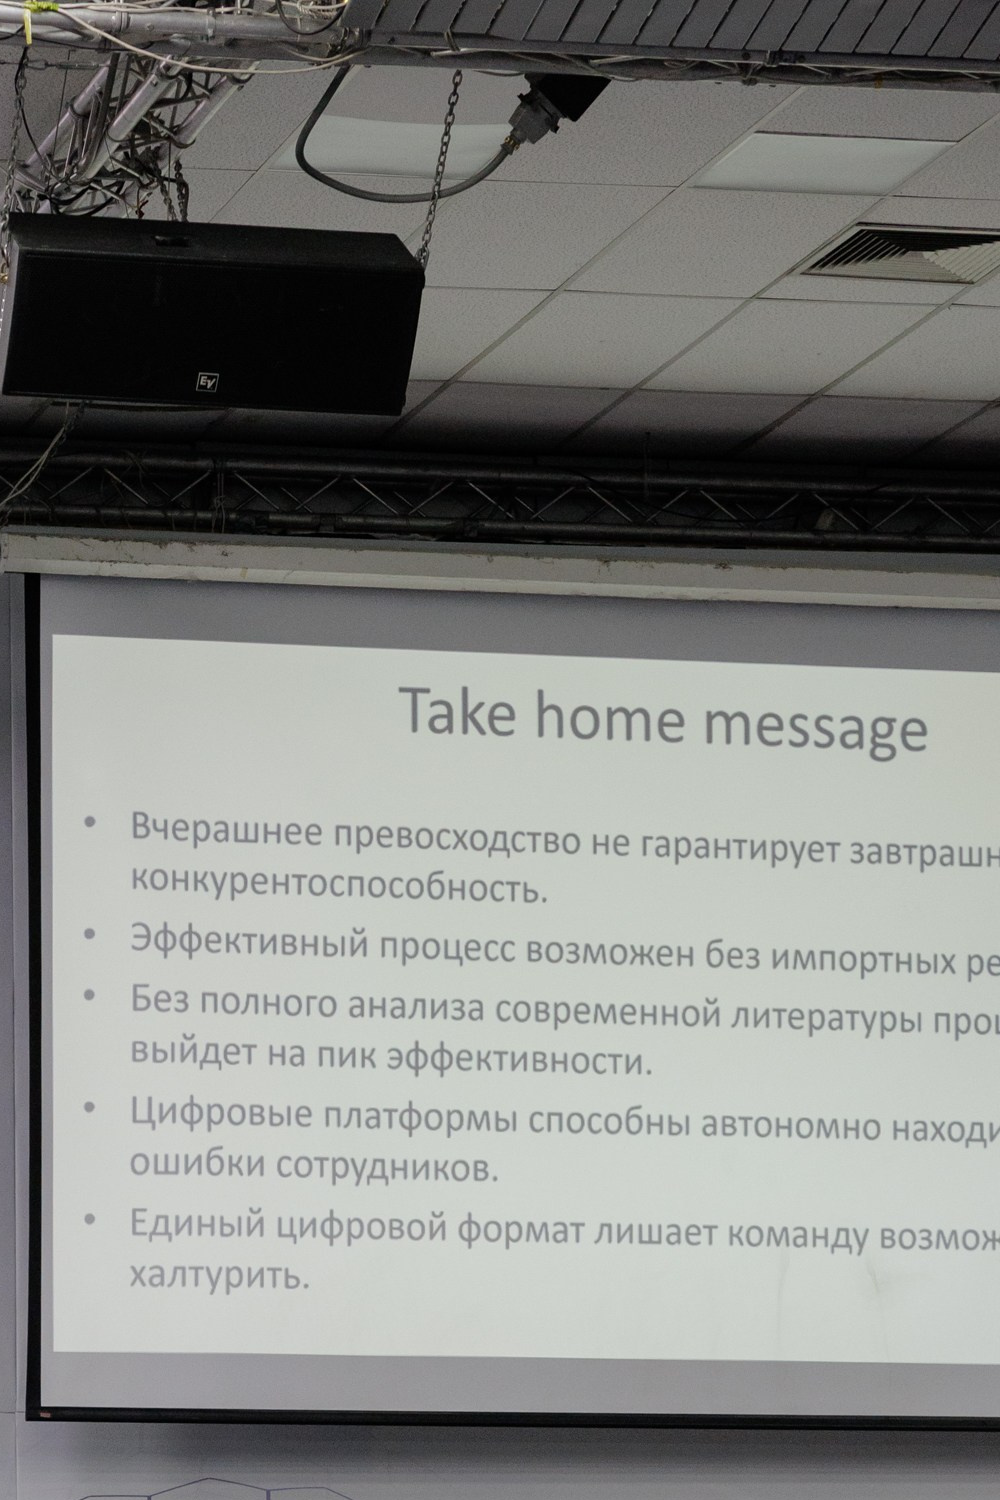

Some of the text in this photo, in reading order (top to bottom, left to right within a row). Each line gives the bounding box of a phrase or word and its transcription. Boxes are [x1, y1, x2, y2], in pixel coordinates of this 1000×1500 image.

[398, 686, 927, 762] Take home message
[133, 811, 1000, 873] Вчерашнее превосходство не гарантирует завтрашн
[133, 868, 547, 903] конкурентоспособность.
[132, 921, 1000, 982] Эффективный процесс возможен без импортных ре
[133, 984, 189, 1013] Без
[202, 992, 337, 1017] полного
[349, 996, 483, 1021] анализа
[496, 997, 720, 1030] современной
[731, 1007, 921, 1039] литературы
[132, 1033, 651, 1078] выйдет на пик эффективности.
[132, 1095, 312, 1132] Цифровые
[325, 1100, 516, 1138] платформы
[529, 1105, 689, 1136] способны
[702, 1115, 881, 1140] автономно
[130, 1146, 497, 1186] ошибки сотрудников.
[132, 1207, 264, 1242] Единый
[278, 1209, 446, 1247] цифровой
[458, 1212, 585, 1250] формат
[594, 1223, 718, 1246] лишает
[729, 1225, 869, 1256] команду
[130, 1265, 309, 1295] халтурить.
